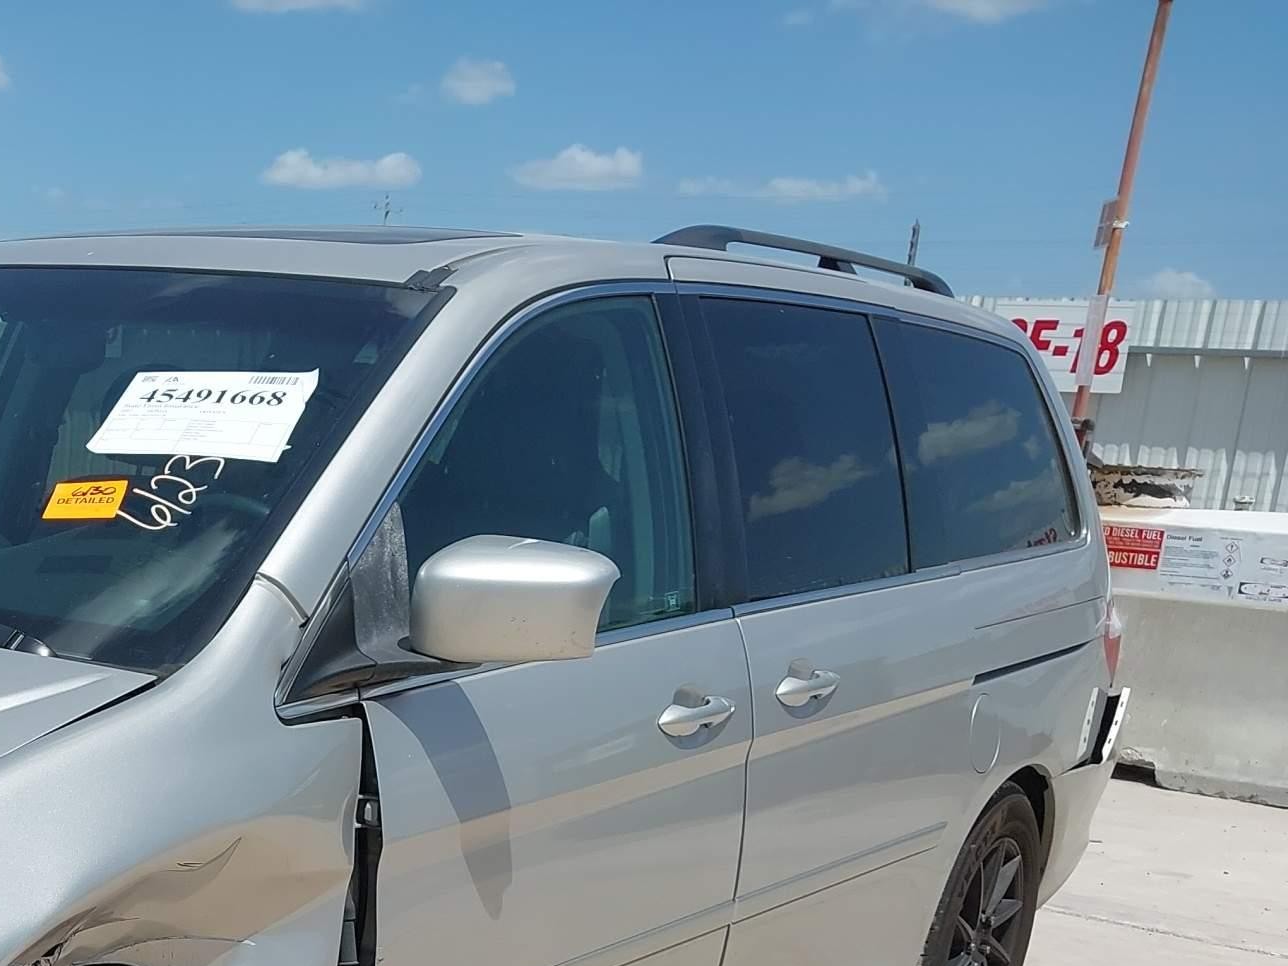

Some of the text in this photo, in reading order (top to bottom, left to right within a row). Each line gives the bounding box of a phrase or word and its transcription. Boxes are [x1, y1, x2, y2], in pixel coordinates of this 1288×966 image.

[1012, 318, 1128, 375] F-18
[139, 388, 287, 407] 45491668
[56, 496, 115, 505] DETAILED
[1112, 527, 1139, 538] DIESEL
[1142, 529, 1162, 540] FUEL
